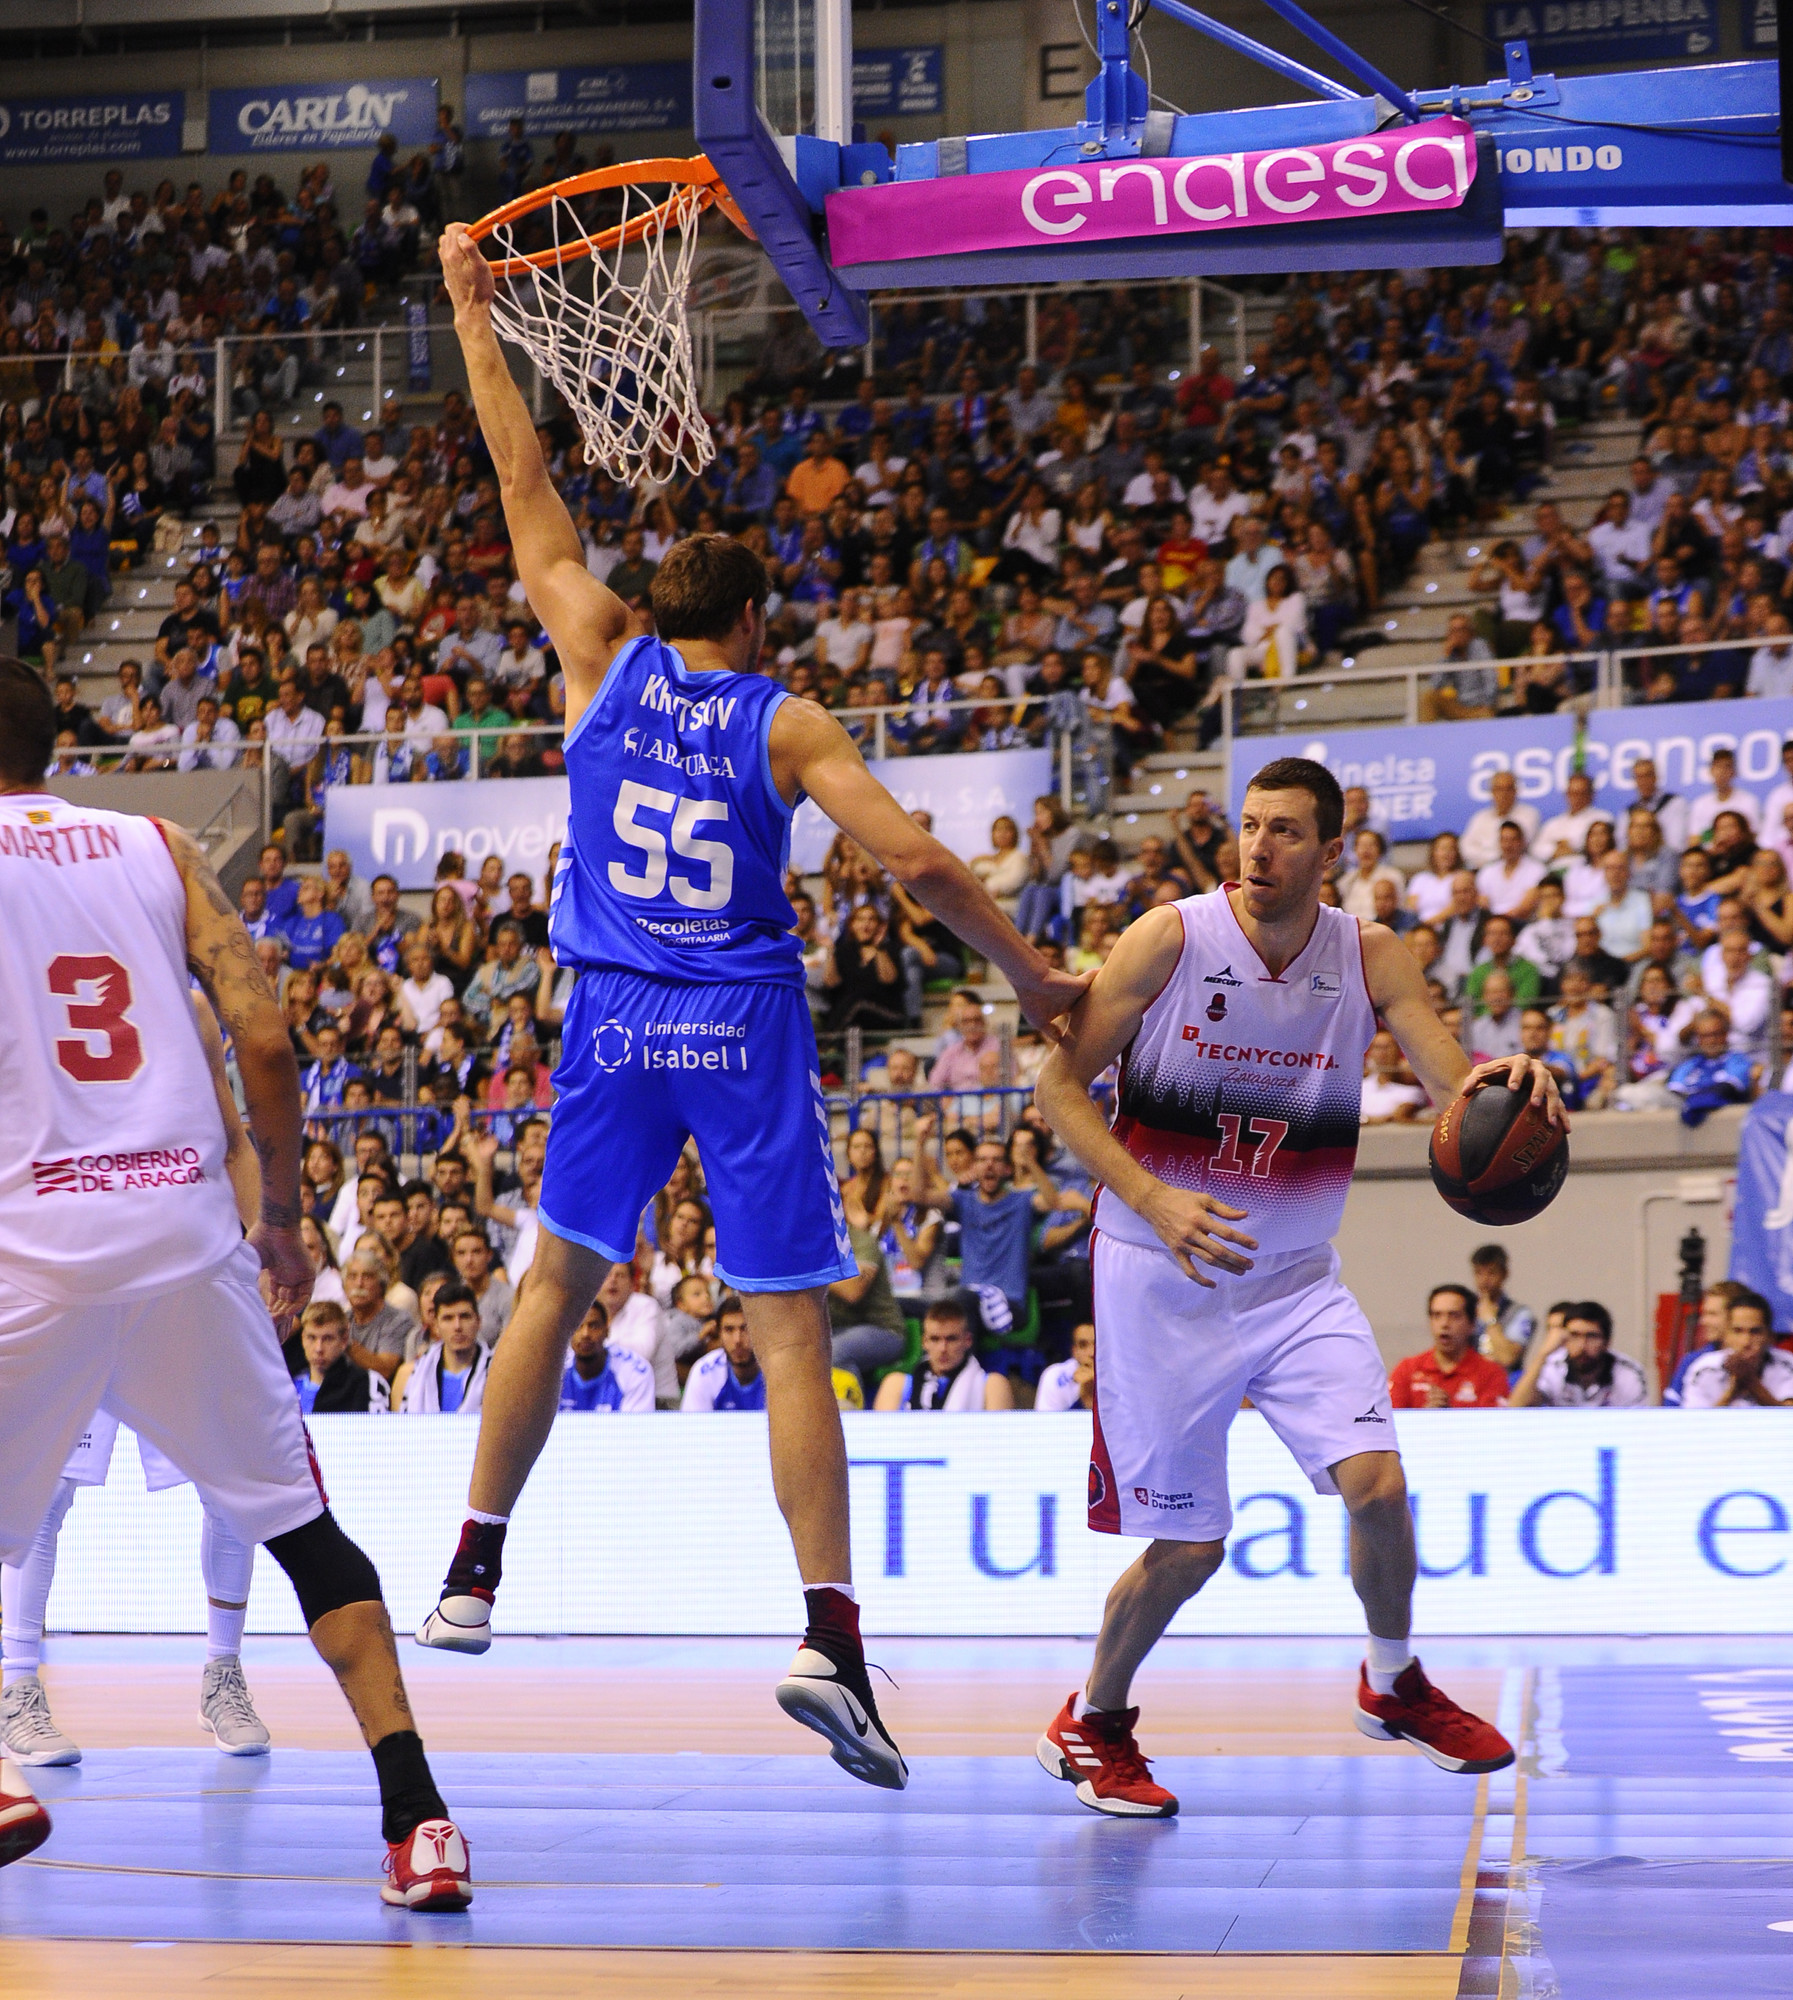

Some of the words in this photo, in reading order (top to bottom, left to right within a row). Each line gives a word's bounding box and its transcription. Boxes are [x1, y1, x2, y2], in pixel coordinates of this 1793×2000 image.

[1040, 42, 1082, 100] E
[20, 102, 172, 131] TORREPLAS
[1019, 134, 1469, 236] endesa
[1467, 729, 1793, 800] ascenso
[607, 778, 734, 911] 55
[1203, 975, 1244, 987] MERCURY
[47, 953, 146, 1085] 3
[644, 1019, 746, 1038] Universidad
[643, 1043, 730, 1070] Isabel
[1222, 1066, 1298, 1092] Zaragoza
[78, 1147, 200, 1172] GOBIERNO
[1208, 1112, 1289, 1179] 17
[81, 1174, 115, 1192] DE
[1354, 1416, 1387, 1424] MERCURY
[1150, 1489, 1193, 1502] Zaragoza
[848, 1457, 1058, 1580] Tu
[1230, 1446, 1618, 1580] aud
